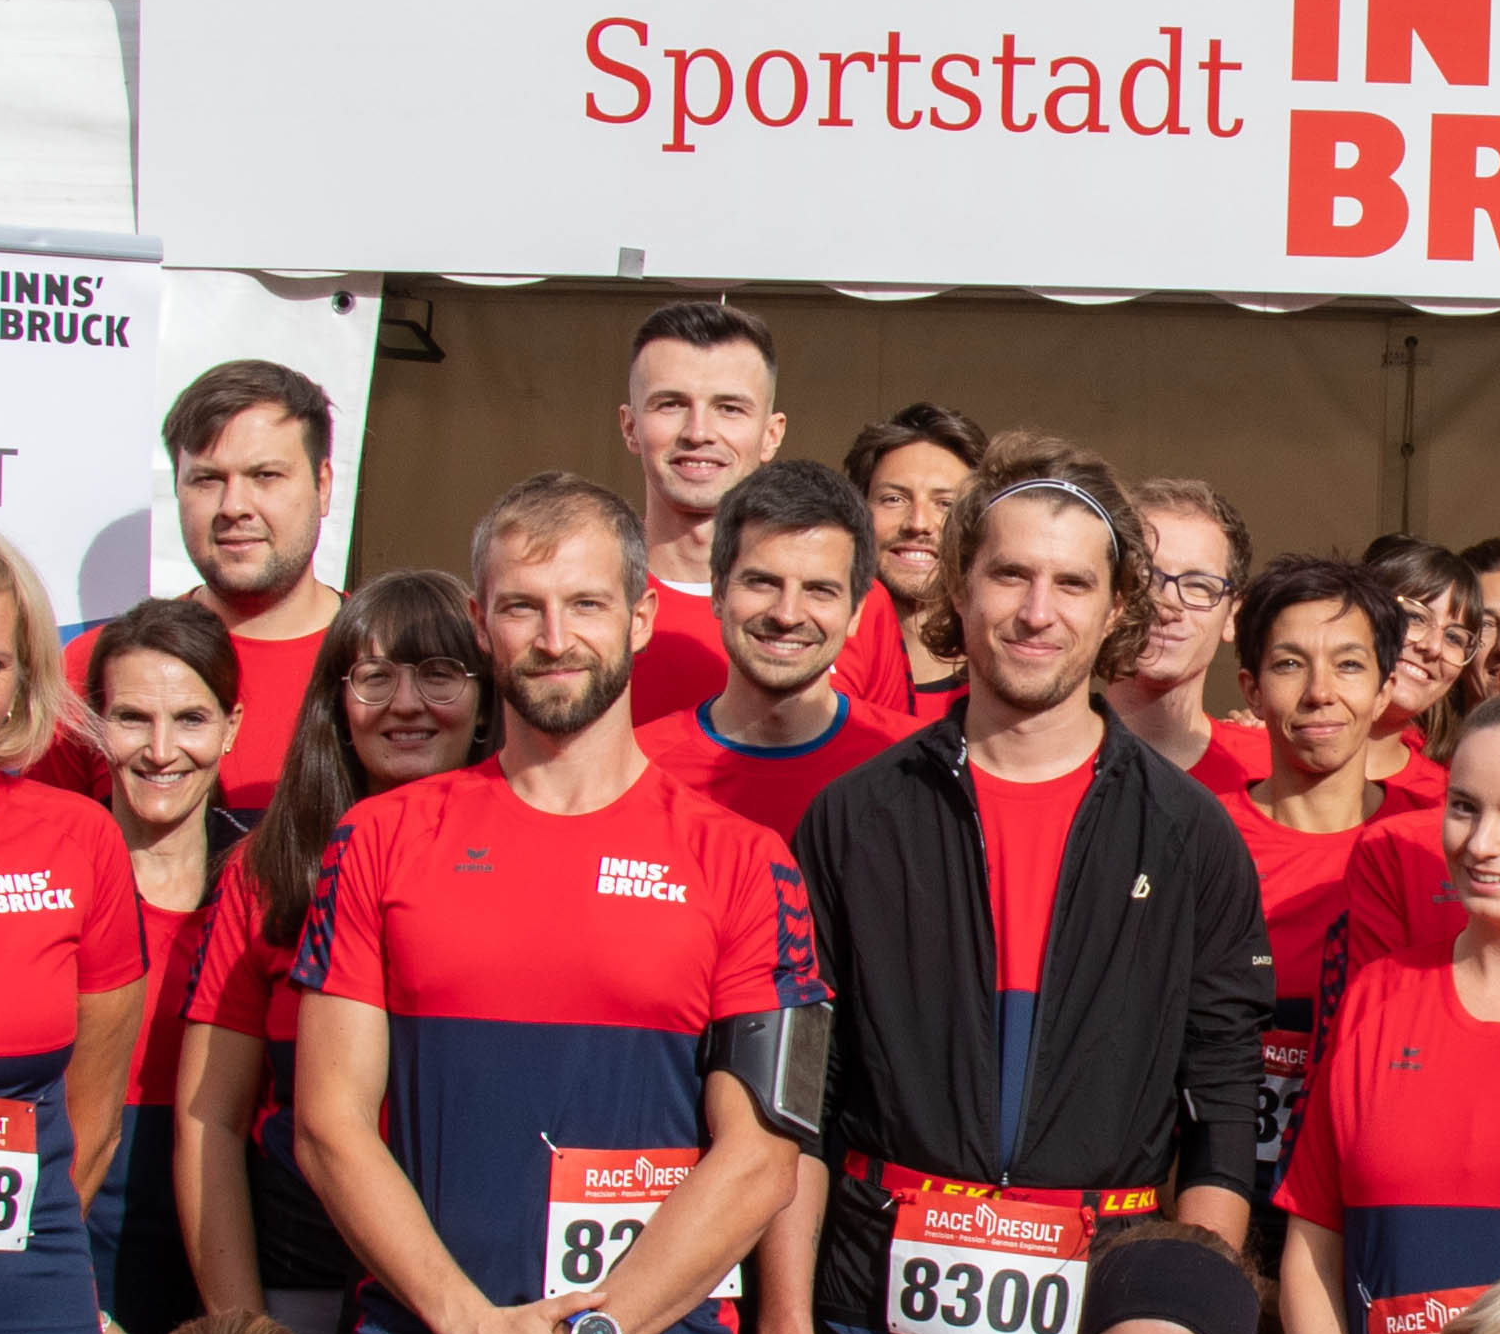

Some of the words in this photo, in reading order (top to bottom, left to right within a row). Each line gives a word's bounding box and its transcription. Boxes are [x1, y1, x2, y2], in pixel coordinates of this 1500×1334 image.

[582, 16, 1245, 152] Sportstadt
[0, 270, 103, 308] INNS'
[0, 308, 130, 348] BRUCK
[600, 856, 670, 882] INNS'
[597, 874, 688, 904] BRUCK
[585, 1168, 634, 1188] RACE
[654, 1166, 695, 1186] RES
[1104, 1187, 1156, 1212] LEKI
[925, 1208, 973, 1232] RACE
[997, 1217, 1065, 1244] RESULT
[1386, 1312, 1427, 1334] RACE
